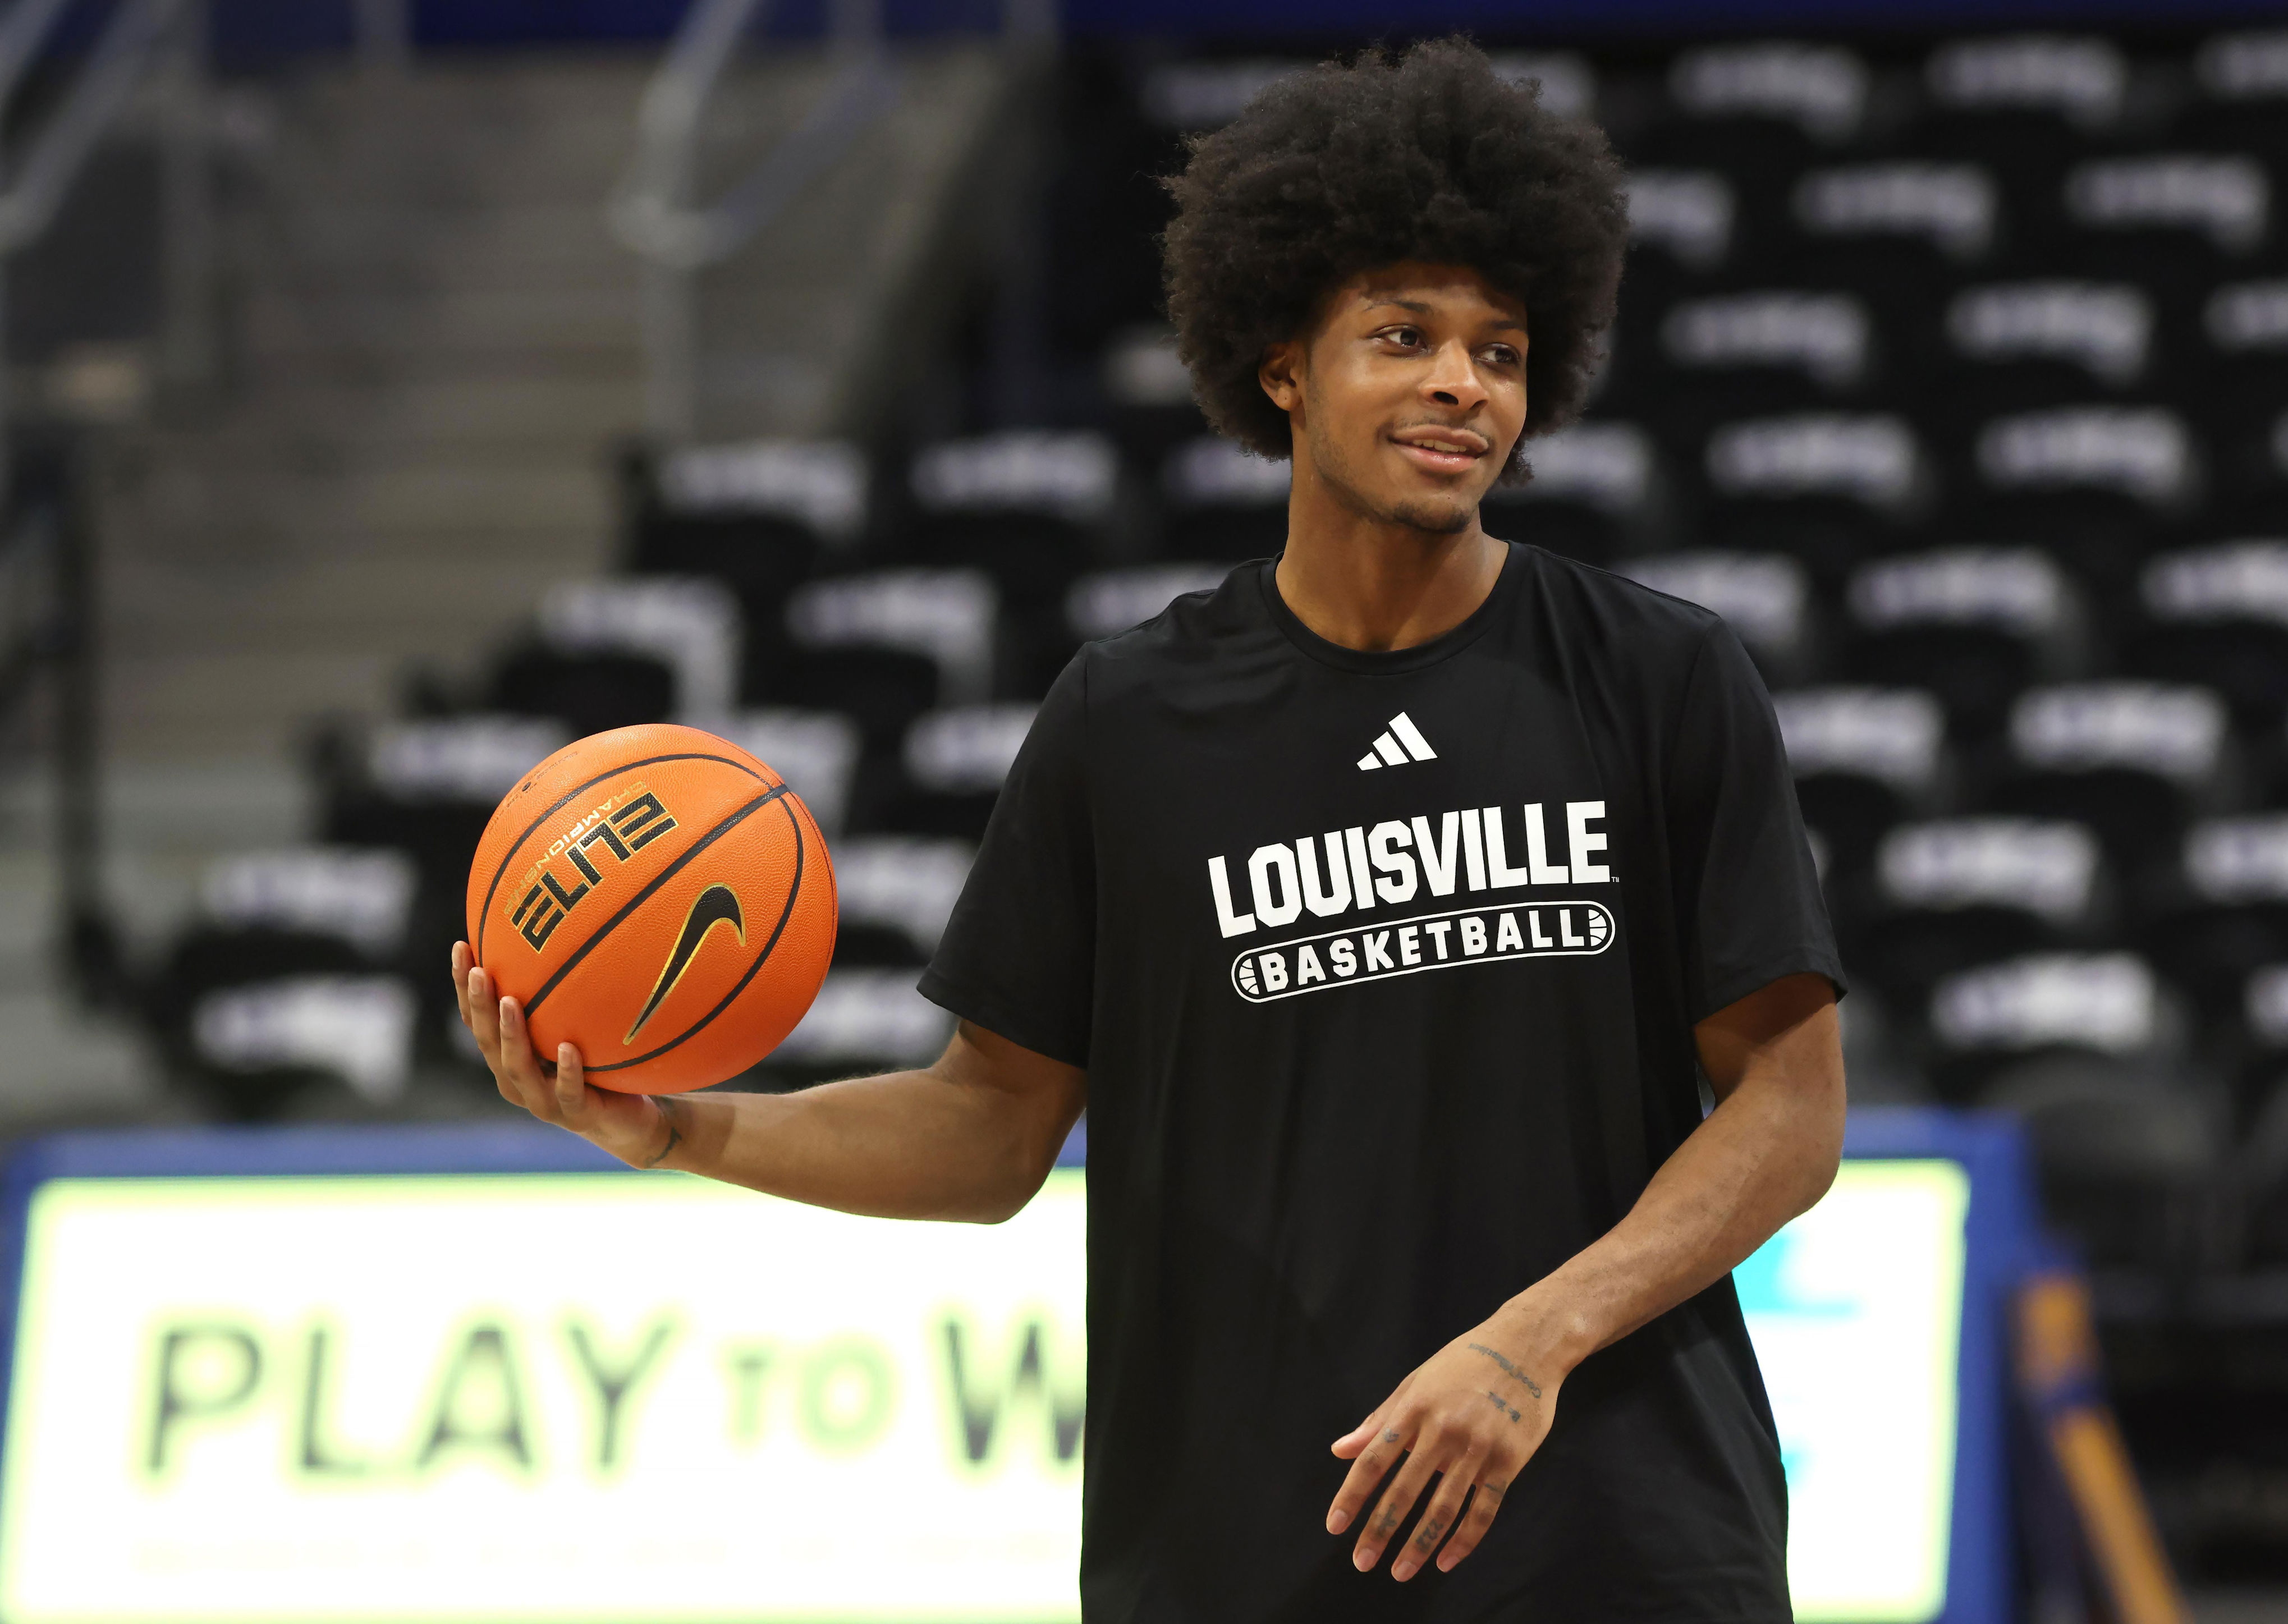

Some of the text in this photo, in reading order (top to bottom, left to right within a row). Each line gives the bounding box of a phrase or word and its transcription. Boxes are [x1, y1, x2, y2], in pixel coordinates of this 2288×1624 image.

[503, 781, 648, 915] CHAMPIONSHIP
[510, 790, 679, 955] ELITE
[1208, 800, 1610, 939] LOUISVILLE
[1259, 909, 1585, 993] BASKETBALL
[140, 1319, 680, 1477] PLAY
